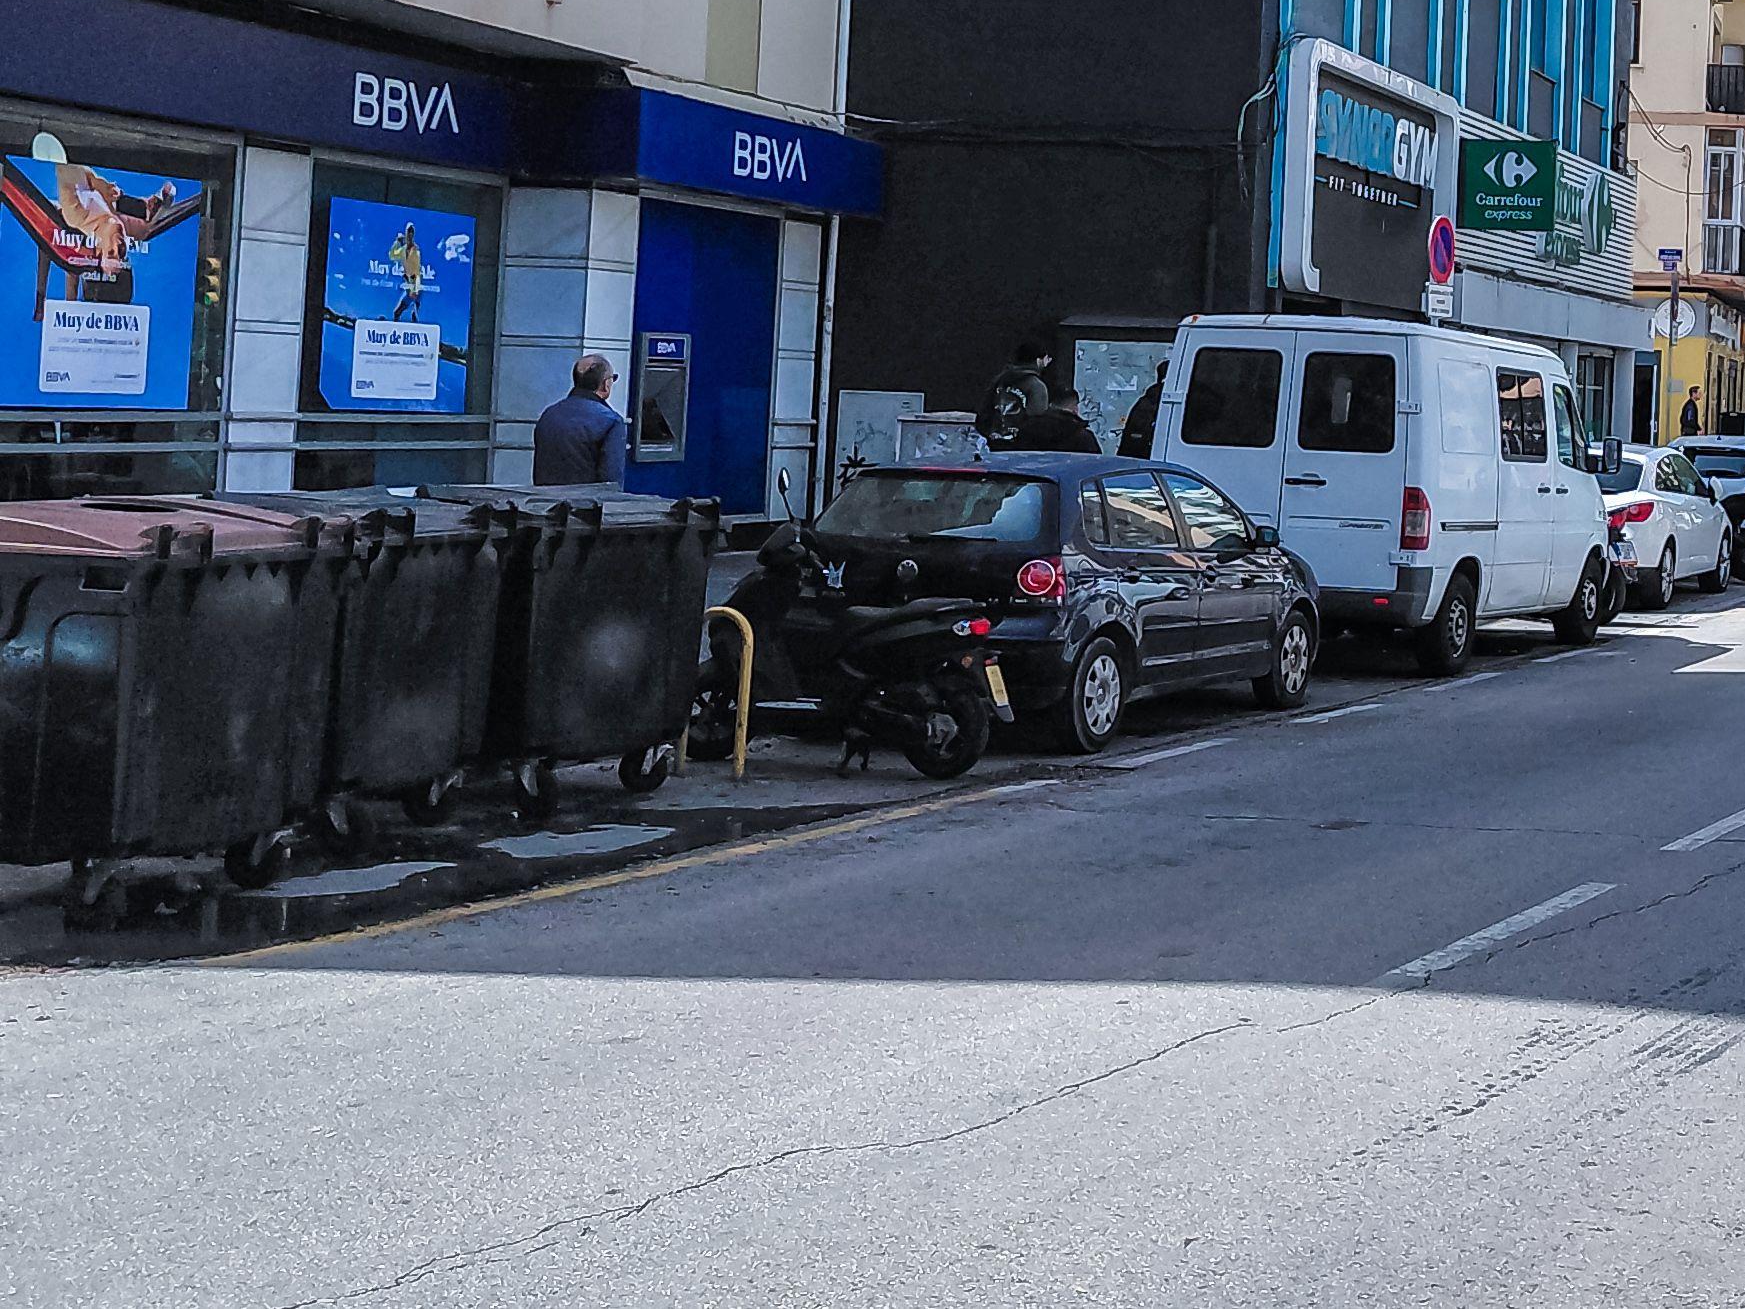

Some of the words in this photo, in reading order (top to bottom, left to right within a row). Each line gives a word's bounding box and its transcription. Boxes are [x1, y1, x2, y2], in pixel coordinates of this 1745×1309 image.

[353, 72, 459, 134] BBVA
[733, 131, 807, 182] BBVA
[1329, 176, 1345, 192] FIT
[1351, 181, 1399, 206] TOGETHER
[1475, 192, 1544, 207] Carrefour
[1484, 210, 1533, 222] express
[52, 228, 85, 253] Muy
[53, 311, 84, 333] Muy
[86, 312, 102, 330] de
[104, 314, 139, 332] BBVA
[366, 329, 388, 348] Muy
[389, 330, 402, 345] de
[402, 332, 429, 347] BBVA
